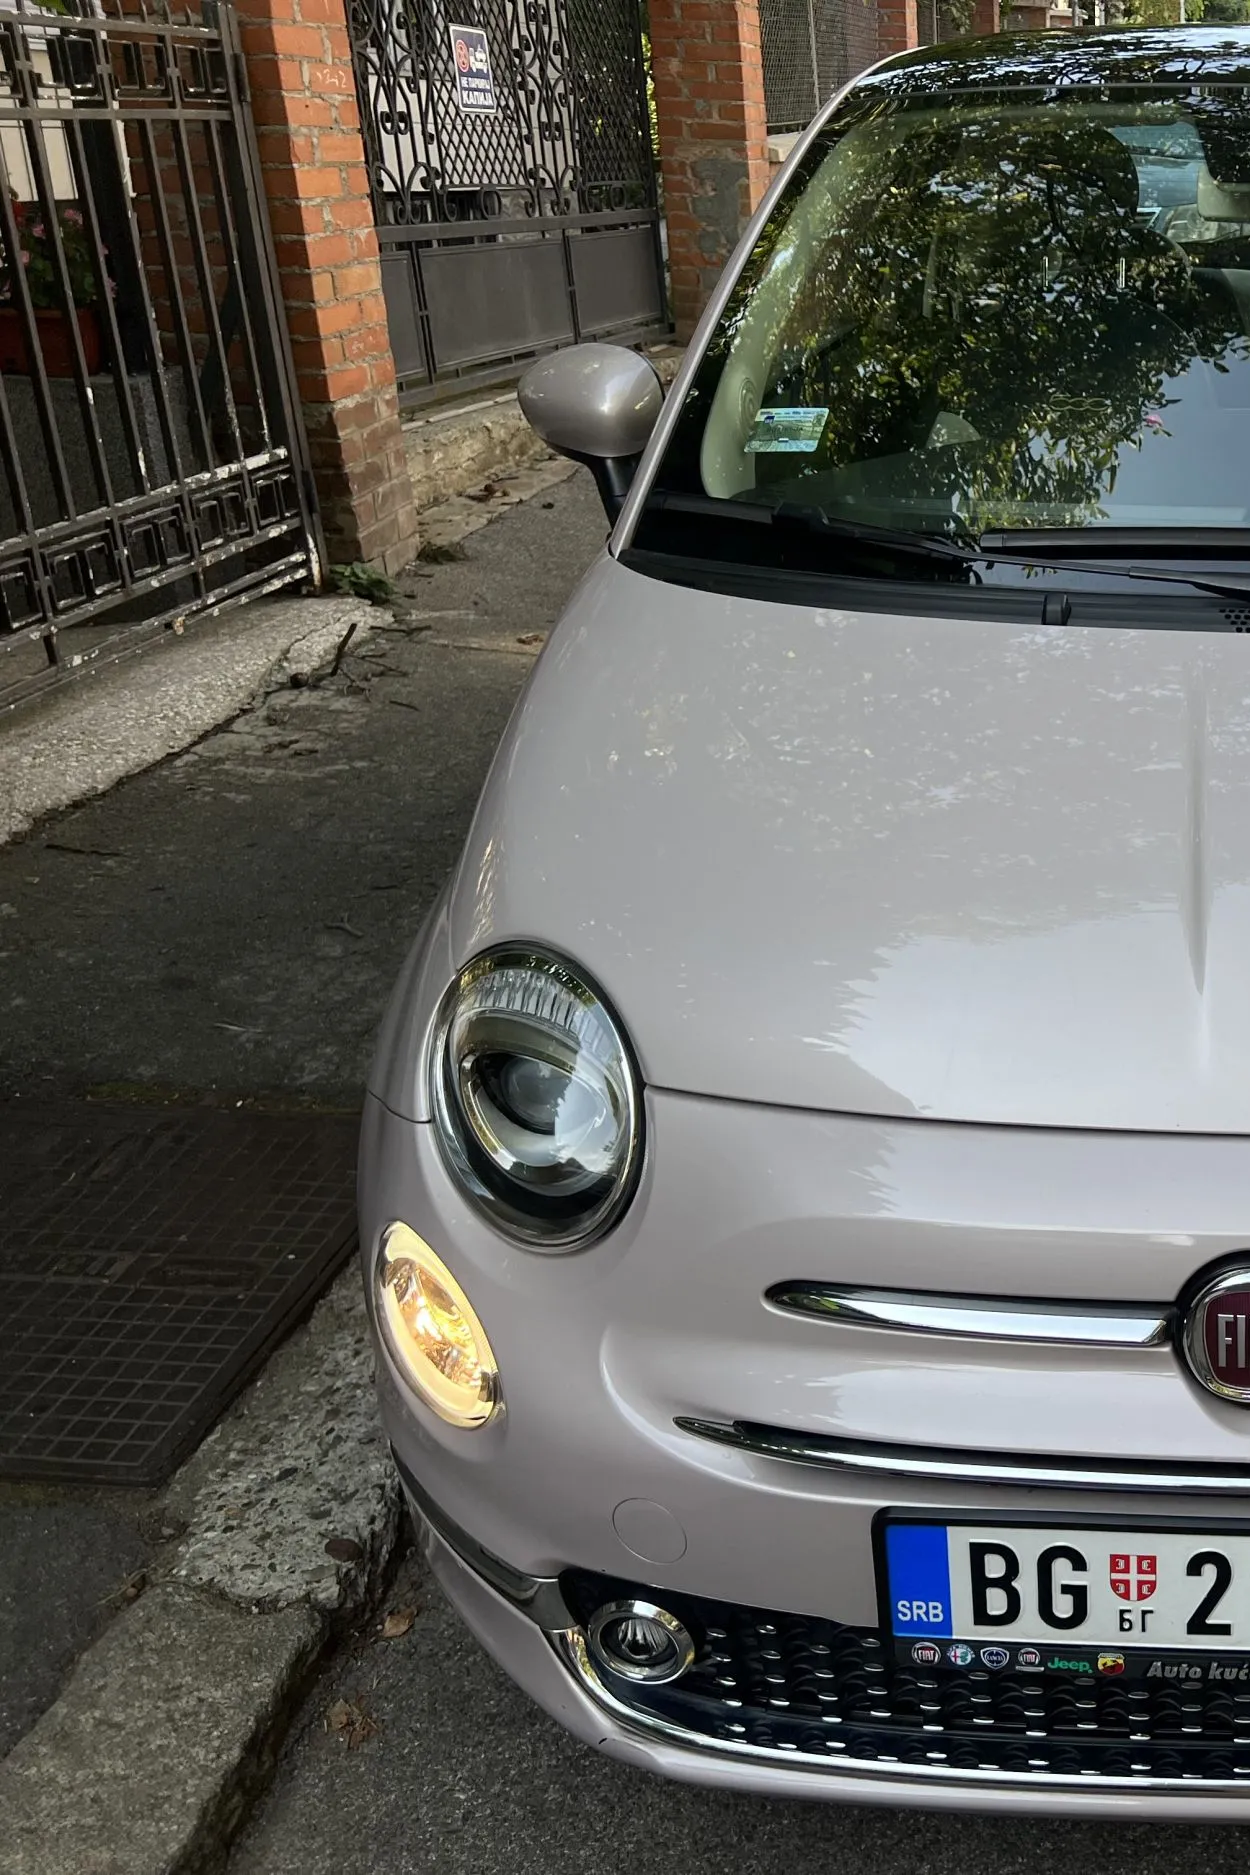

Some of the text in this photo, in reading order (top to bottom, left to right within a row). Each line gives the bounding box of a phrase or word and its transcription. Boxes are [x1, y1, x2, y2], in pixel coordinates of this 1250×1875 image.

[462, 90, 494, 106] КАПИЈА
[968, 1541, 1088, 1630] BG
[897, 1600, 944, 1623] SRB
[1118, 1608, 1155, 1632] БГ
[918, 1650, 934, 1661] FIAT
[1023, 1653, 1036, 1662] FIAT
[1048, 1656, 1090, 1673] Jeep
[1147, 1661, 1202, 1679] Auto
